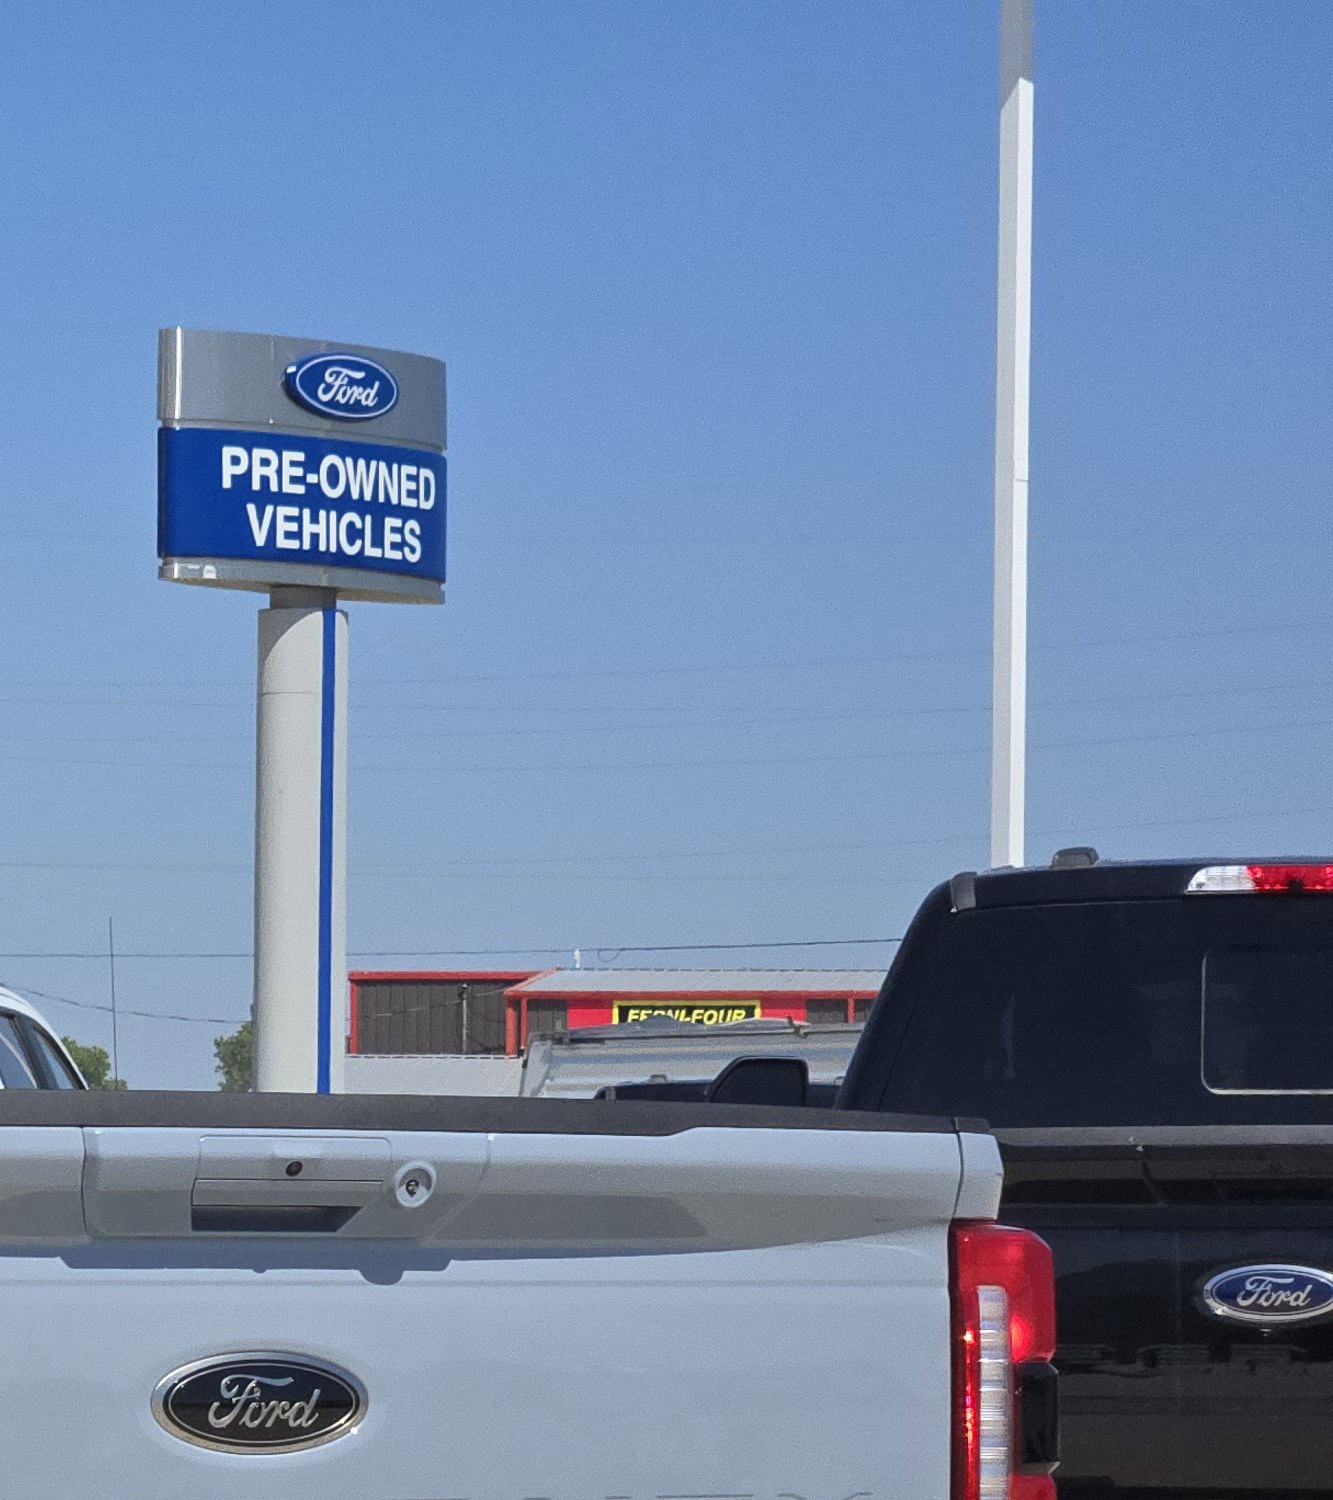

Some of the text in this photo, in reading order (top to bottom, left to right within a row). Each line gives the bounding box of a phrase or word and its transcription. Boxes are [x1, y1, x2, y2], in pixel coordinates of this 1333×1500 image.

[317, 366, 380, 407] Ford
[221, 445, 436, 511] PRE-OWNED
[246, 502, 422, 563] VEHICLES
[1236, 1275, 1313, 1307] Ford
[207, 1373, 322, 1429] Ford
